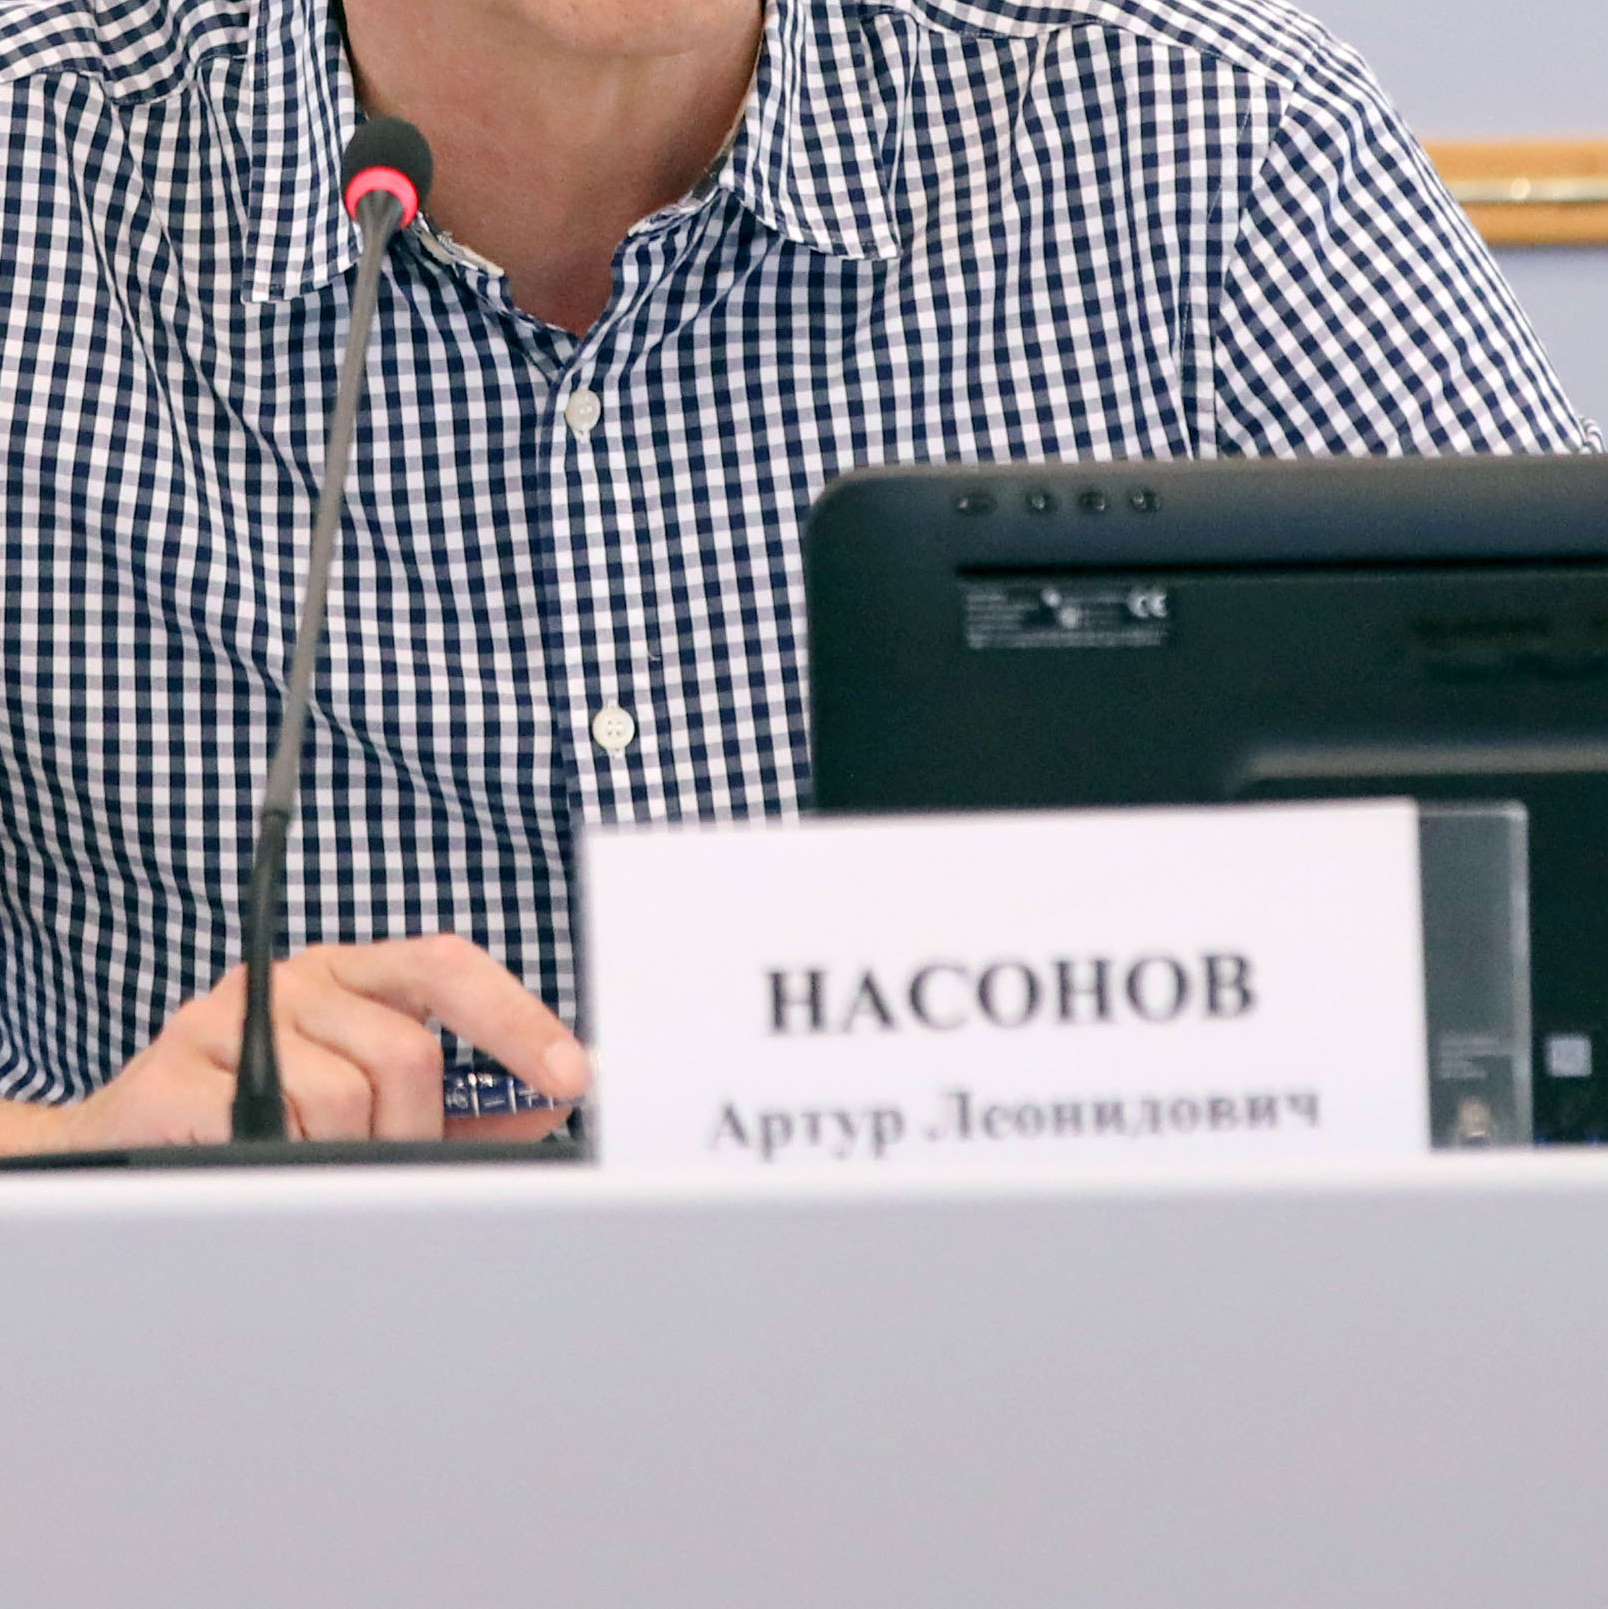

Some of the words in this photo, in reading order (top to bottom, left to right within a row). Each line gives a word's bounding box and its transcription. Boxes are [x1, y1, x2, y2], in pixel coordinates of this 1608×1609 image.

[763, 950, 1258, 1035] НАСОНОВ
[708, 1093, 906, 1159] Артур
[926, 1088, 1321, 1142] Леонидович
